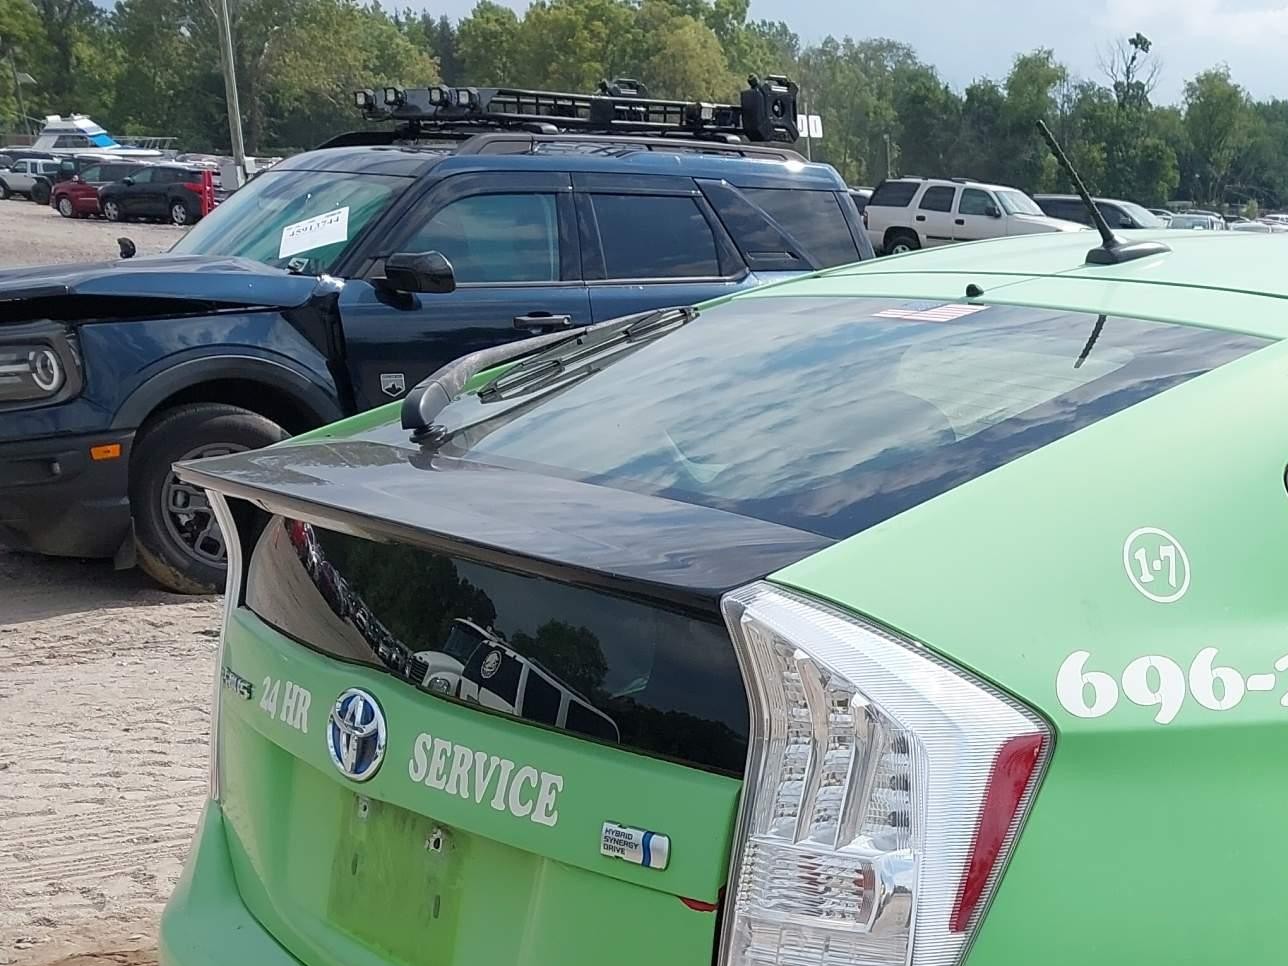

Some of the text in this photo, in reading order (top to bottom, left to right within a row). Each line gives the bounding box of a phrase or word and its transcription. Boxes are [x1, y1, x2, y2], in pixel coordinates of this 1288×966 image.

[260, 676, 565, 827] 24 HR SERVICE
[604, 827, 634, 841] HYBRID
[602, 843, 626, 856] DRIVE
[603, 835, 641, 851] SYNERGY
